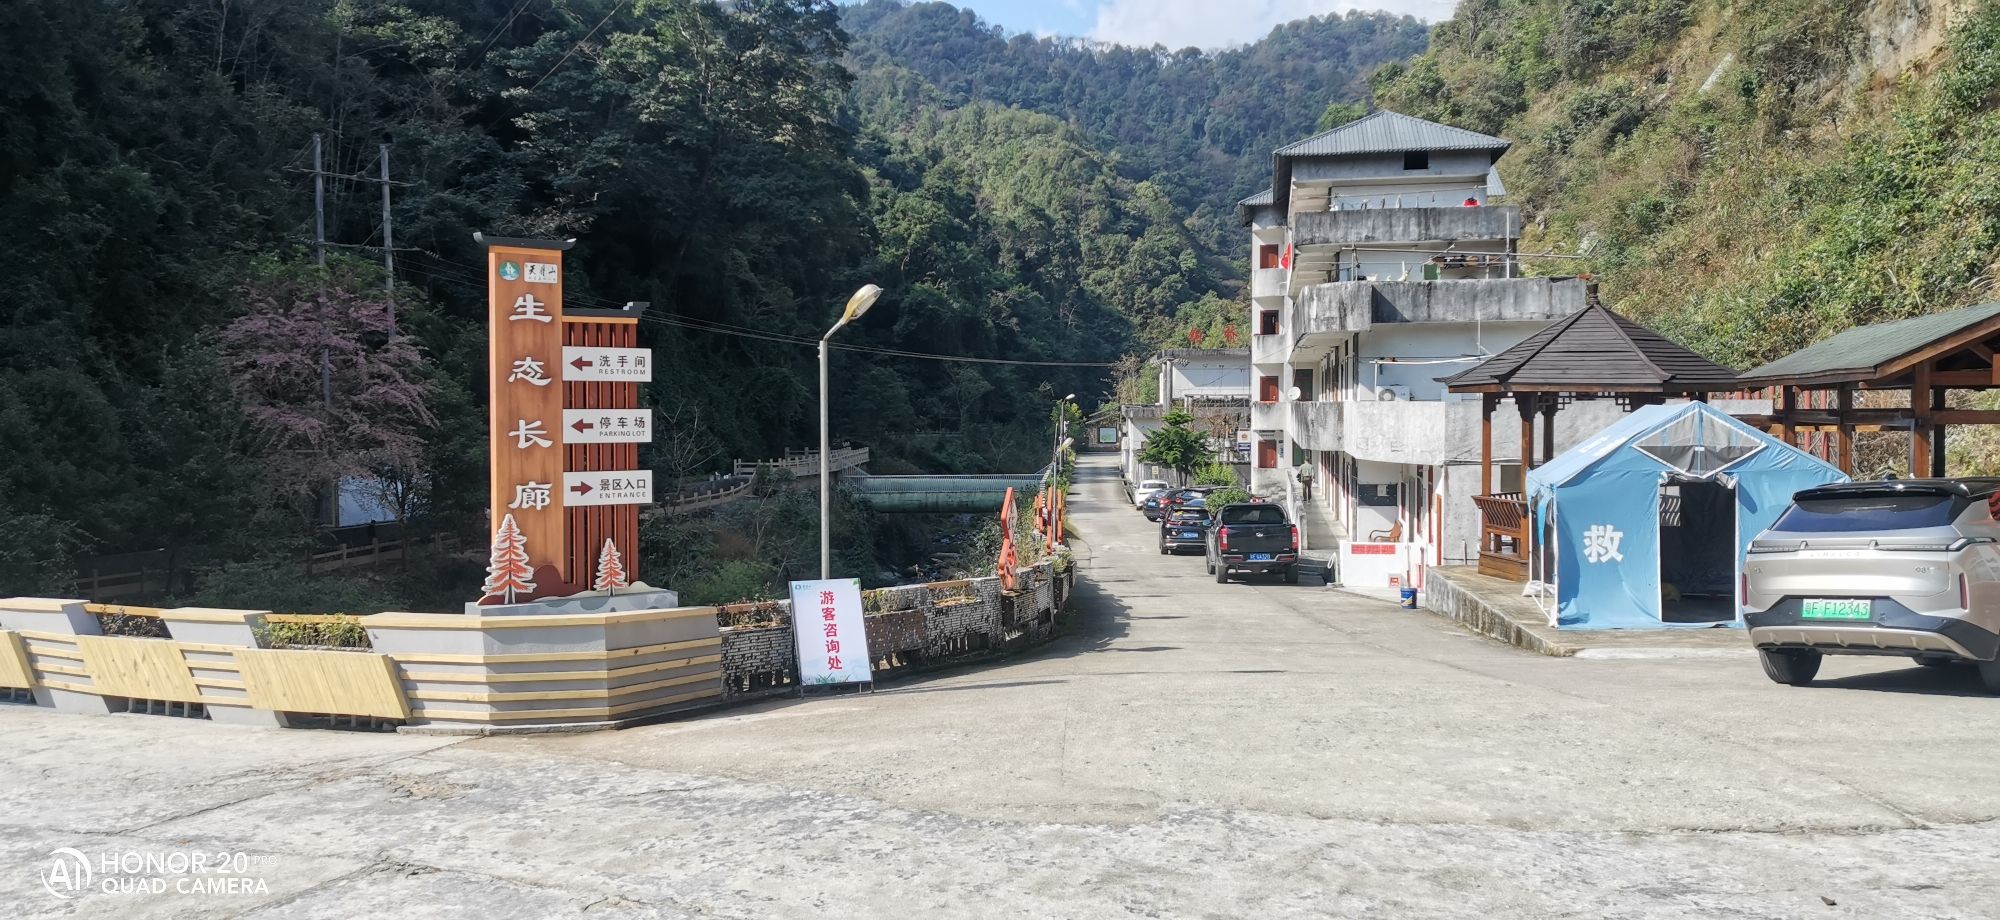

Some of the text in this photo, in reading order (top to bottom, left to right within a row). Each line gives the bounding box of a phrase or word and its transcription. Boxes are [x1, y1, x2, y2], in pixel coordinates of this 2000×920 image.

[599, 355, 646, 367] 洗手间
[508, 293, 554, 511] 生态长廊
[599, 416, 646, 429] 停车场
[599, 478, 646, 491] 景区入口
[1583, 524, 1624, 563] 救
[820, 591, 843, 670] 游客咨询处
